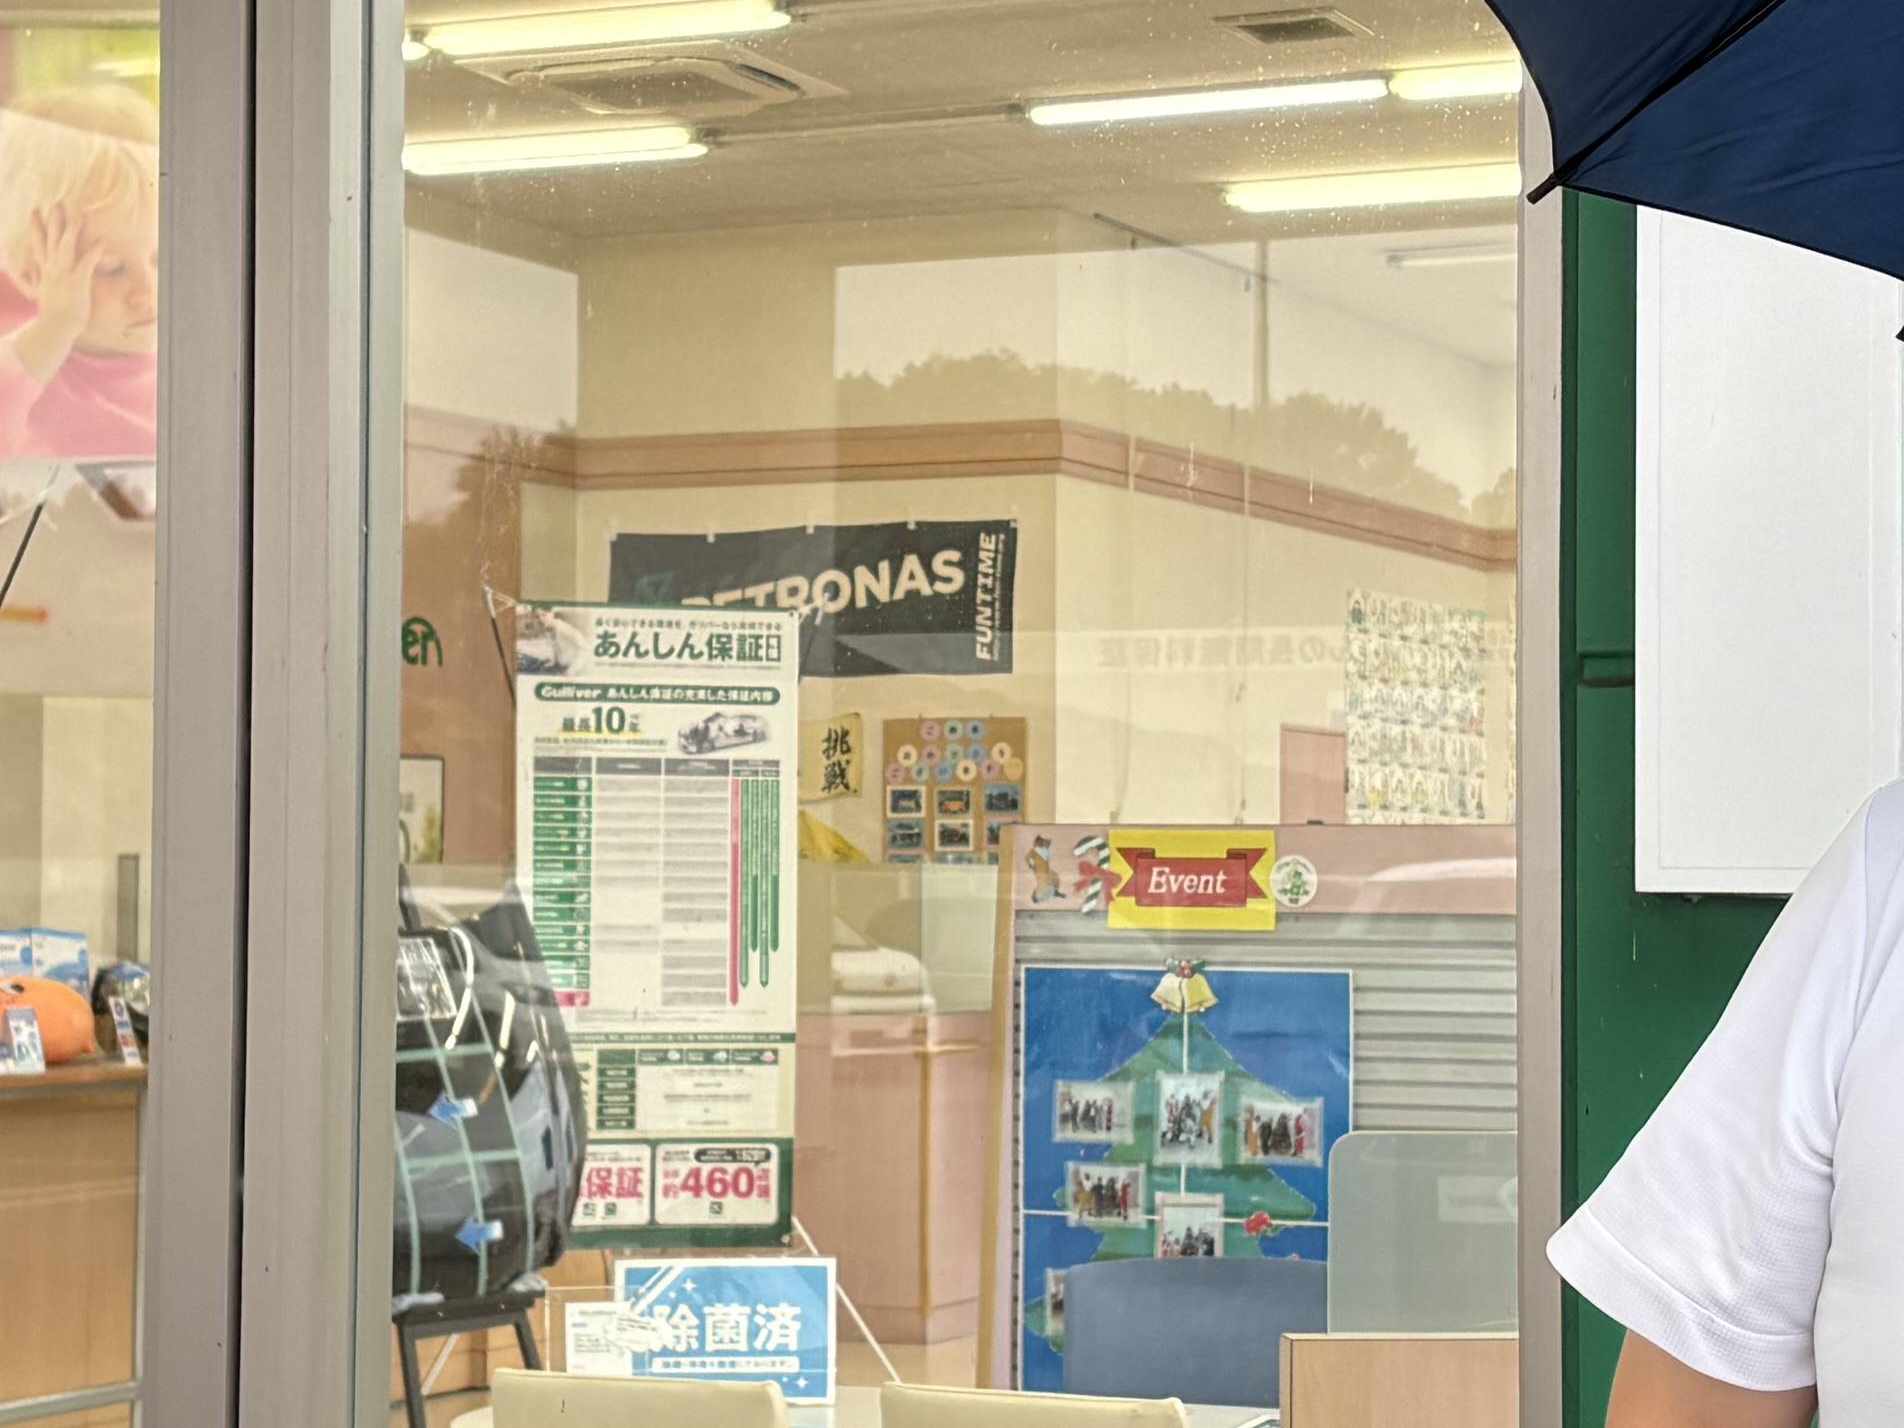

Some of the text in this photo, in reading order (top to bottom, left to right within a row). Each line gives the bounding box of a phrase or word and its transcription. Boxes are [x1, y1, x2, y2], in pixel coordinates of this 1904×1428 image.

[681, 550, 965, 614] TRONAS
[975, 532, 997, 661] FUNTIME
[541, 685, 602, 699] Gulliver
[1147, 866, 1227, 895] Event
[583, 1166, 644, 1200] 保証
[680, 1166, 755, 1200] 460
[650, 1302, 802, 1353] 除菌済
